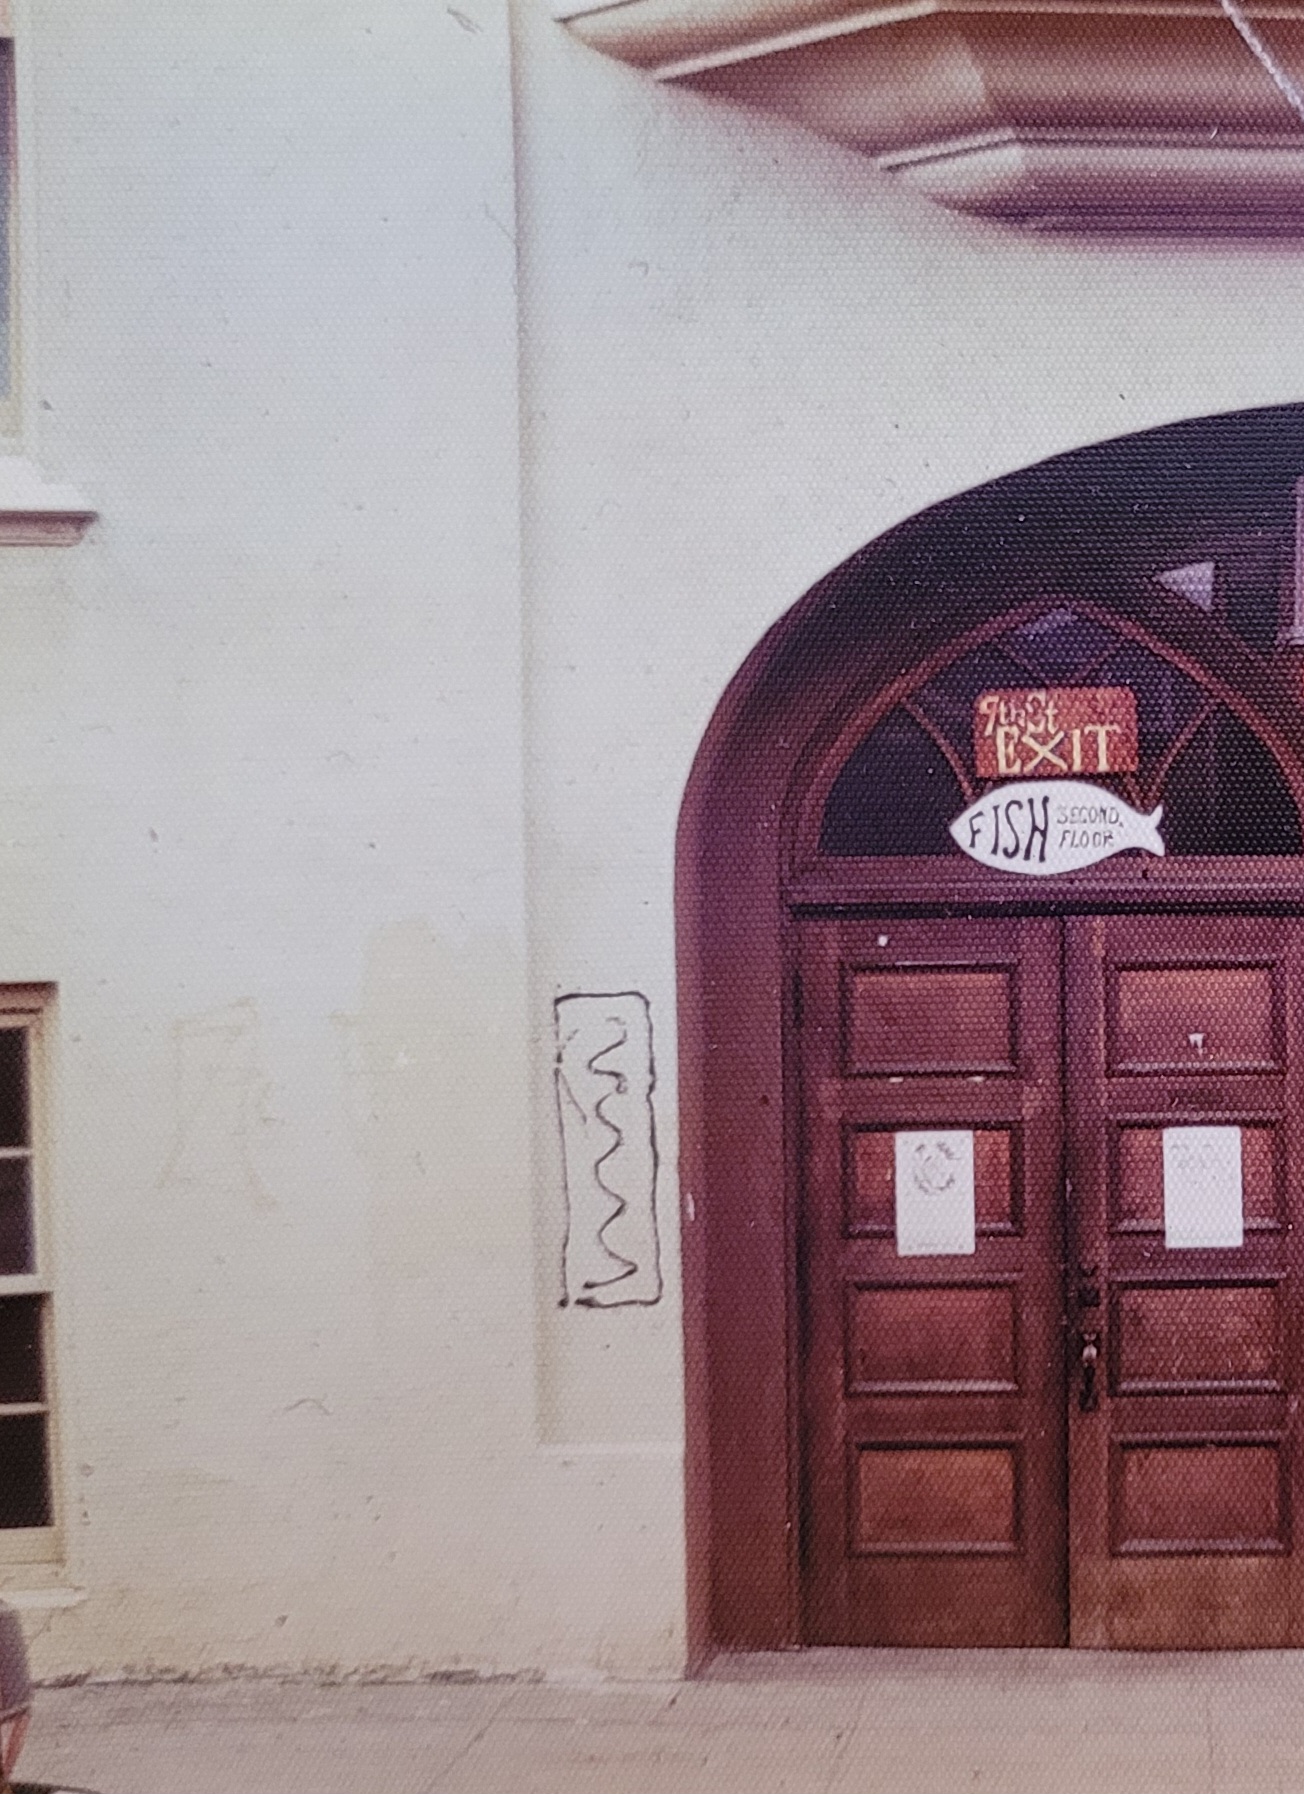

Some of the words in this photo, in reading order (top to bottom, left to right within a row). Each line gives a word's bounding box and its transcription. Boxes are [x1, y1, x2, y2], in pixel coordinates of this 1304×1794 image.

[1025, 686, 1059, 735] St
[996, 724, 1122, 774] EXIT
[968, 795, 1050, 863] FISH
[1058, 829, 1115, 850] FLOOR
